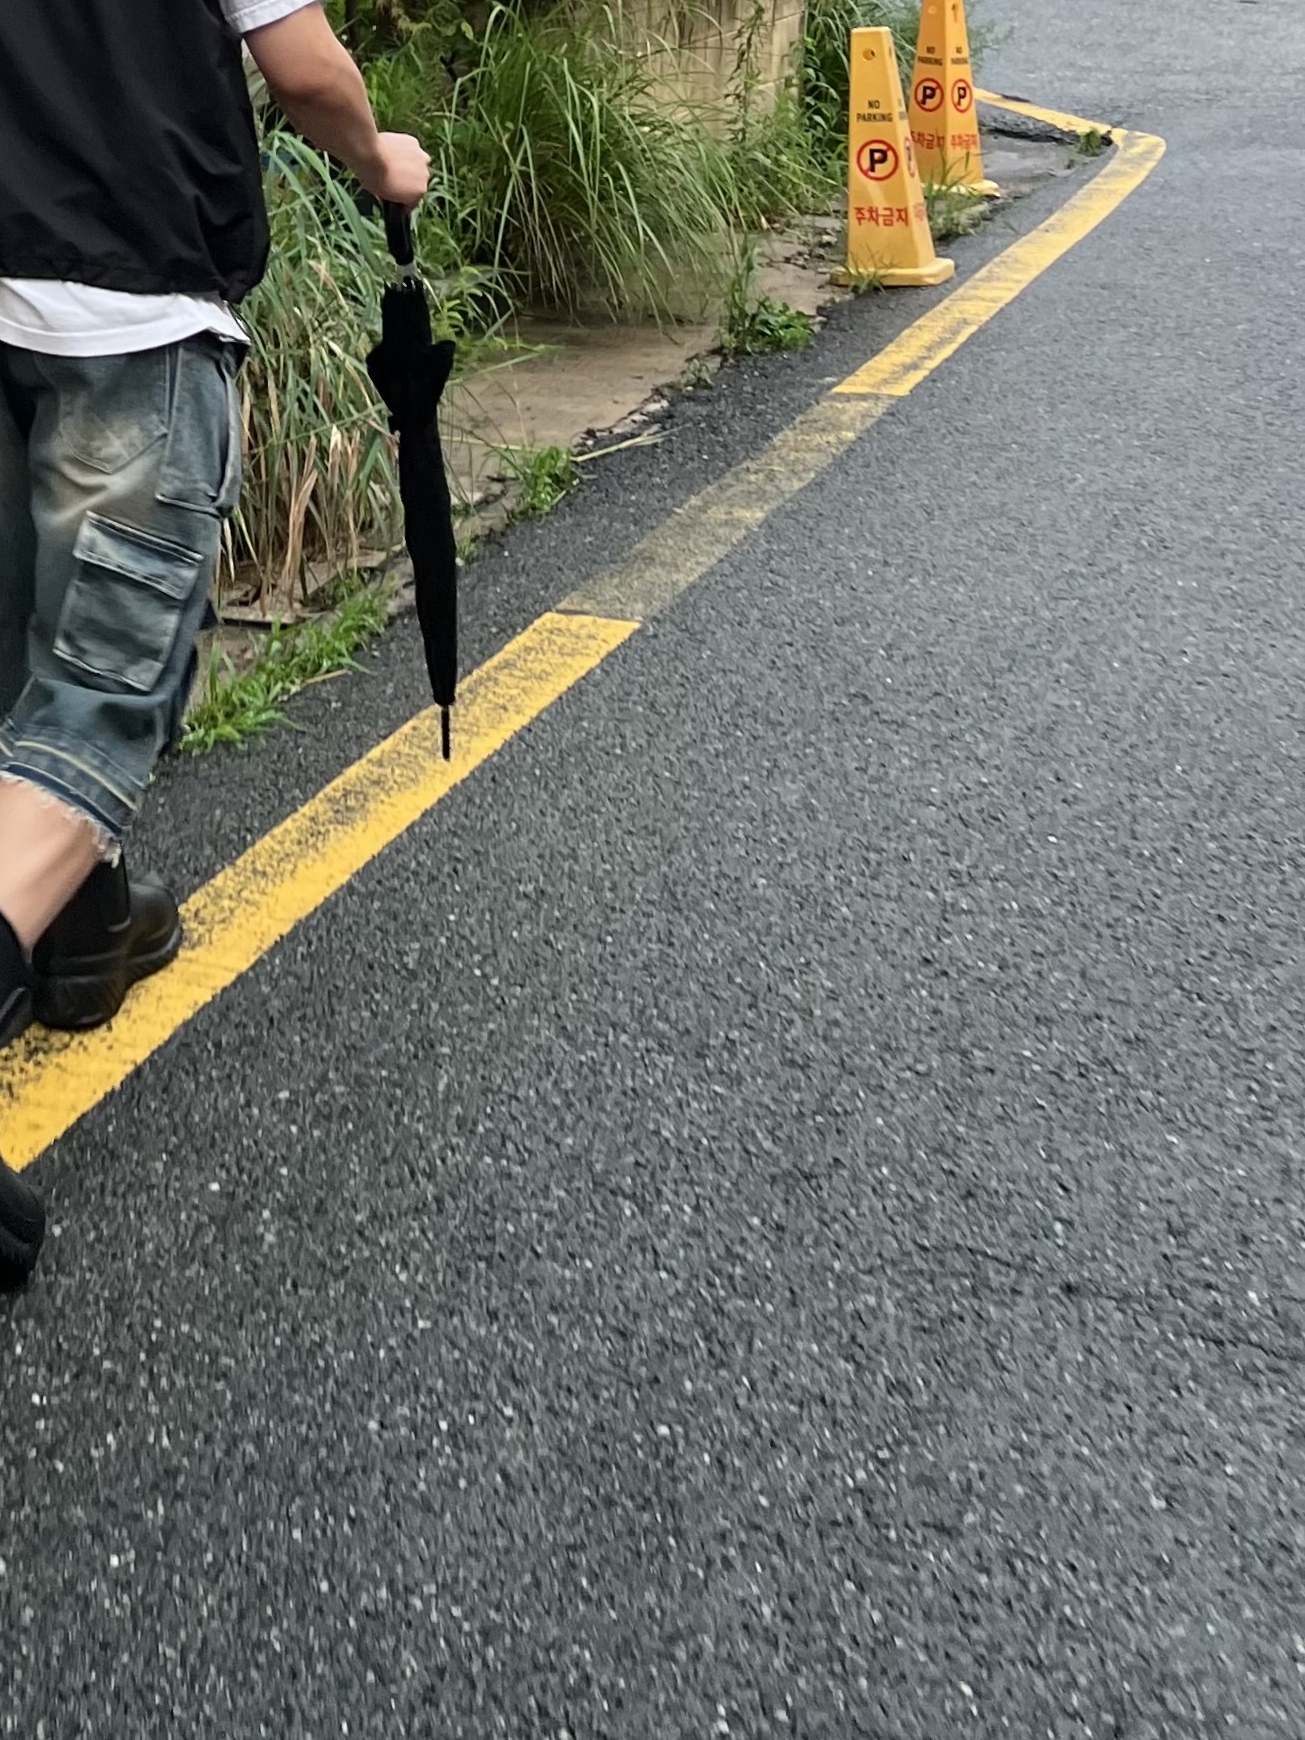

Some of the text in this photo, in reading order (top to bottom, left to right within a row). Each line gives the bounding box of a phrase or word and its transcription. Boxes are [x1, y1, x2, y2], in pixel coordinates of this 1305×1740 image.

[868, 100, 880, 109] NO
[856, 113, 893, 122] PARKING
[854, 206, 909, 227] 주차금지
